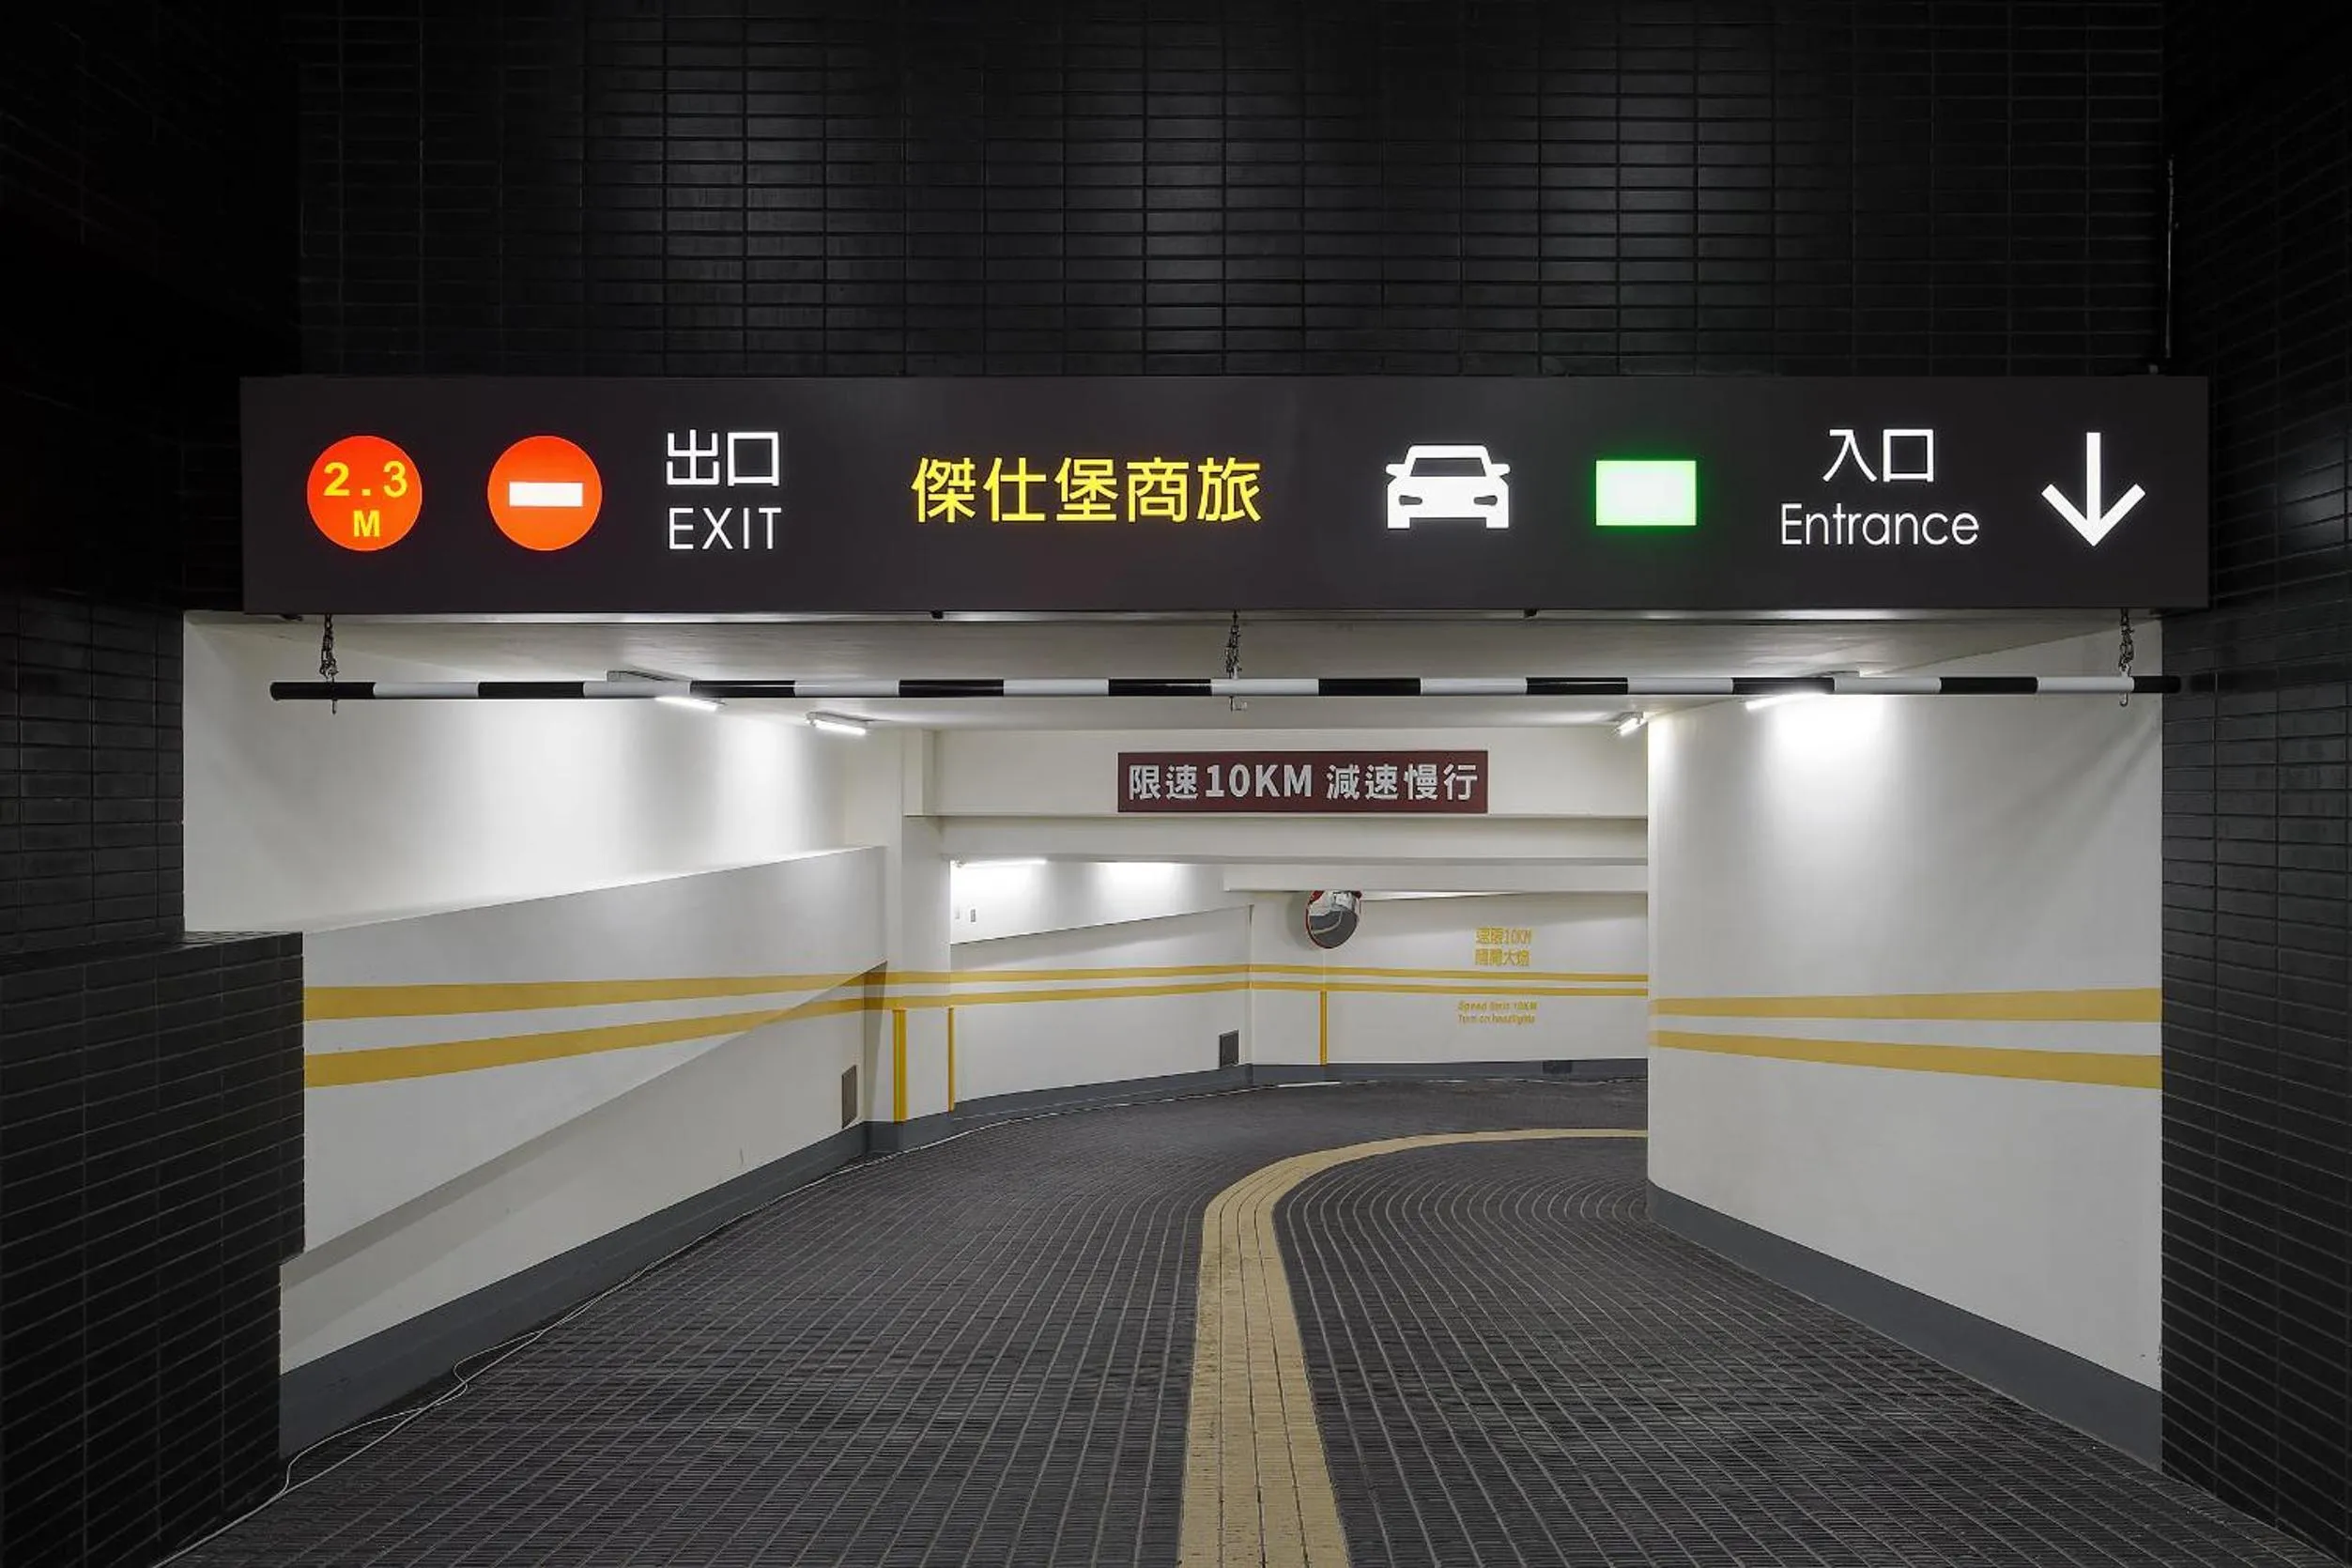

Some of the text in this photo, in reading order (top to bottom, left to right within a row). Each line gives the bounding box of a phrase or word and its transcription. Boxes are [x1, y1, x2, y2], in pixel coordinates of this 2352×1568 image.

[665, 428, 781, 488] 出口
[1822, 428, 1935, 483] 入口
[323, 460, 408, 499] 2.3
[911, 456, 1263, 524] 傑仕堡商旅
[352, 510, 381, 538] M
[668, 507, 782, 550] EXIT
[1780, 503, 1980, 546] Entrance
[1128, 763, 1479, 801] 限速10KM 減速慢行
